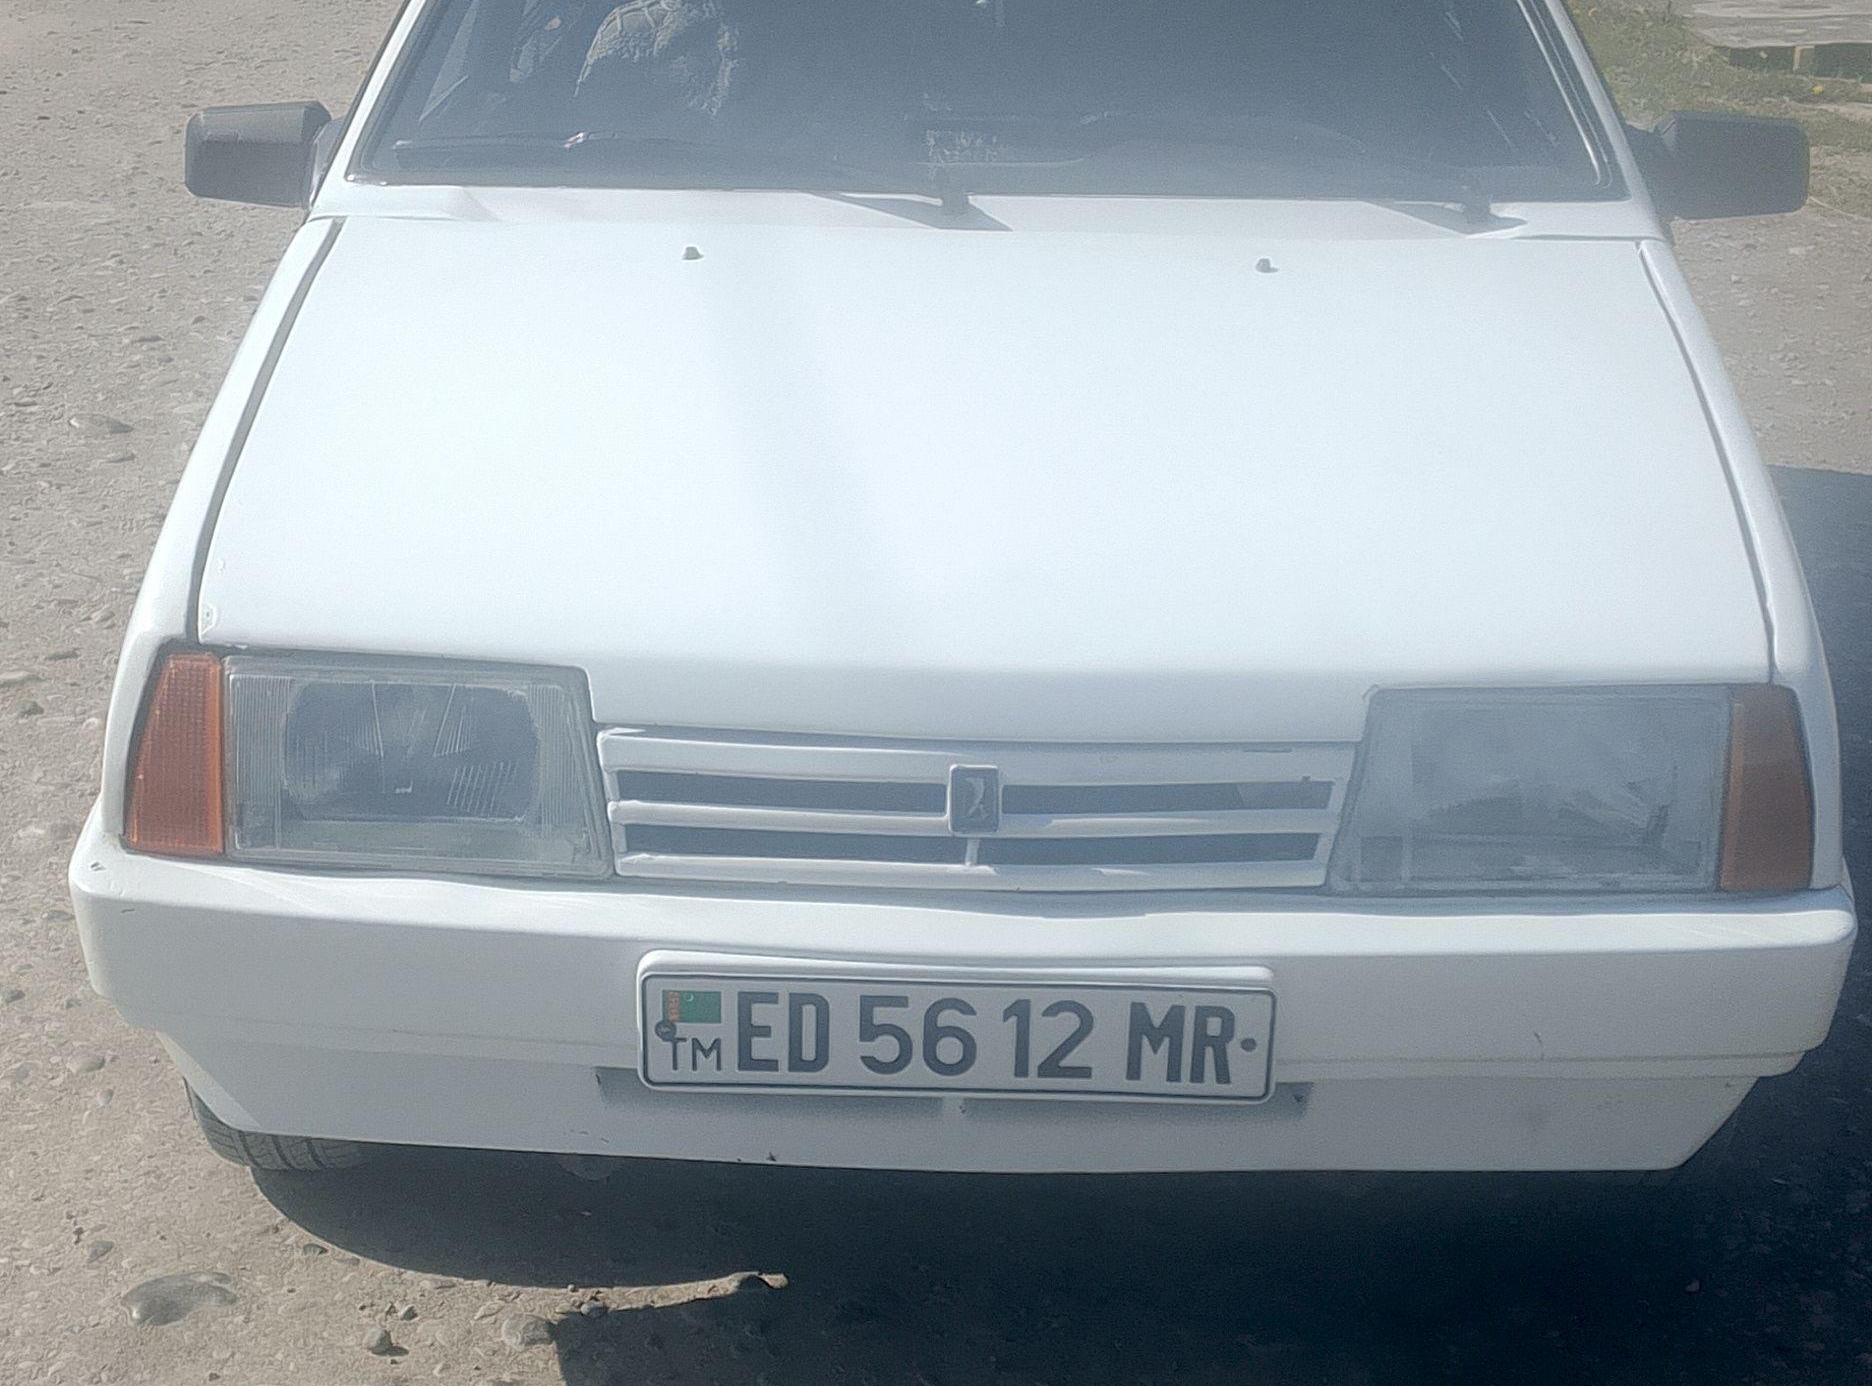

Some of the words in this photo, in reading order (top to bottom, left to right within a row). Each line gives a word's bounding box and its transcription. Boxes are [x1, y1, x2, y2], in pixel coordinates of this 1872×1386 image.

[659, 1036, 722, 1072] TM
[737, 991, 830, 1073] ED
[859, 995, 978, 1076] 56
[1002, 998, 1095, 1079] 12
[1125, 1001, 1236, 1085] MR
